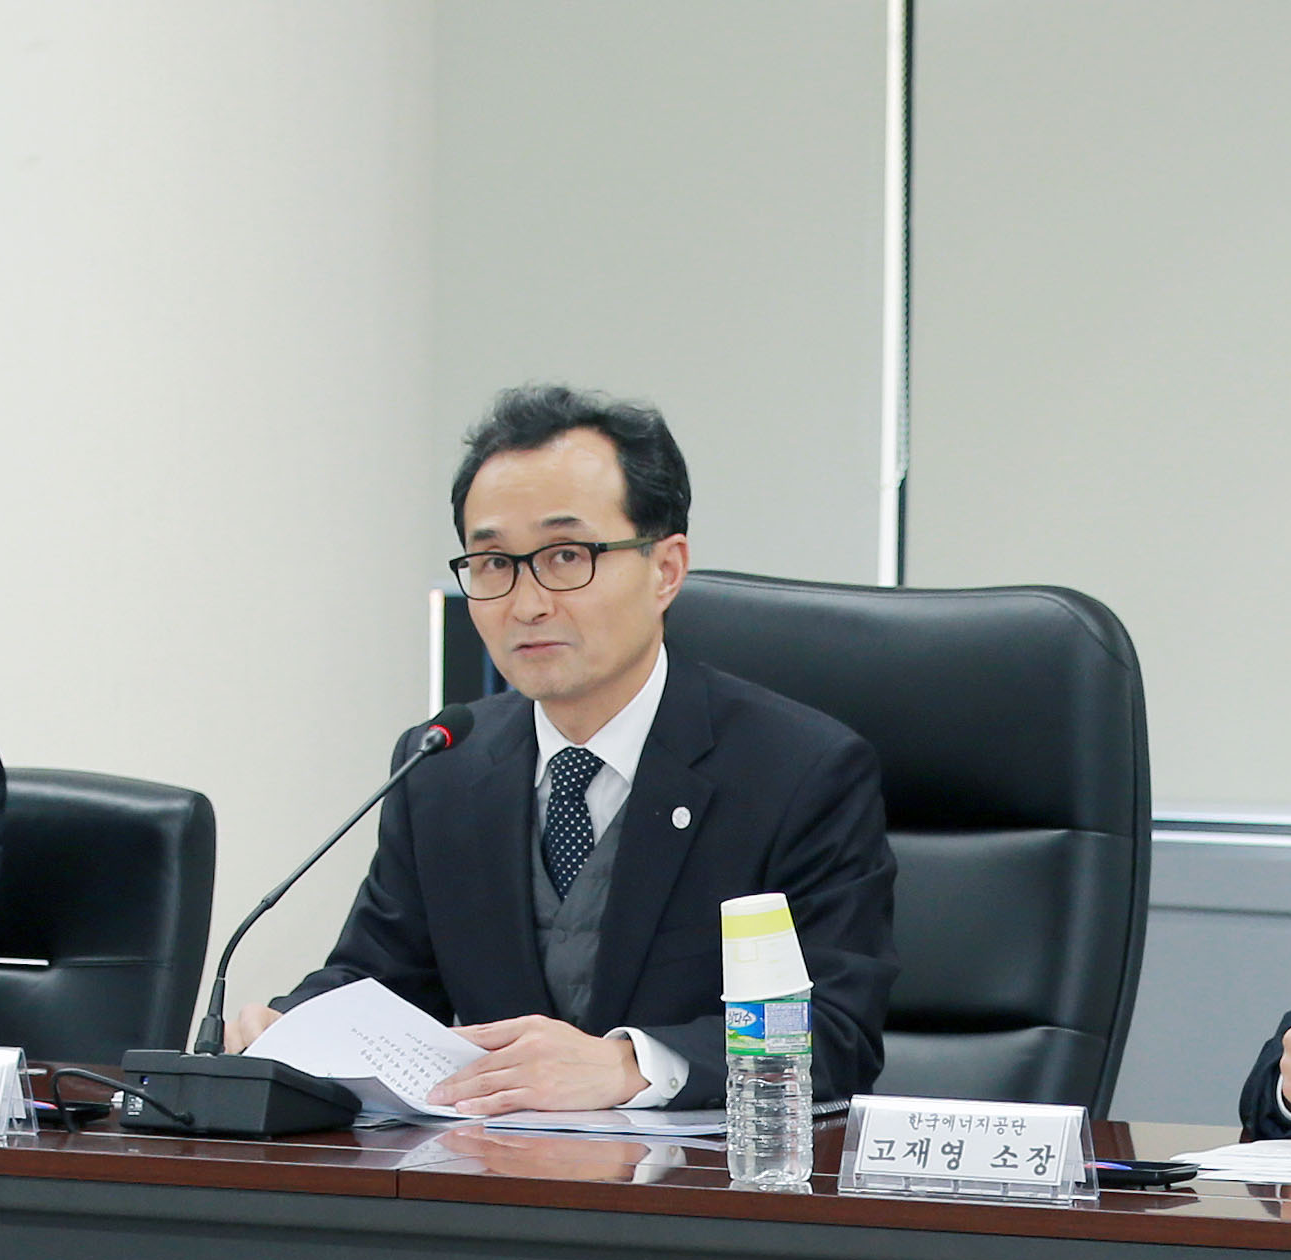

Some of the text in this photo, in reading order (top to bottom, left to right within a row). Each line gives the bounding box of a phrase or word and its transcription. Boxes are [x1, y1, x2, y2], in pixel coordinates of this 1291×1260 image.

[908, 1111, 1028, 1137] 한국에너지공단
[866, 1136, 1056, 1176] 고재영 소장
